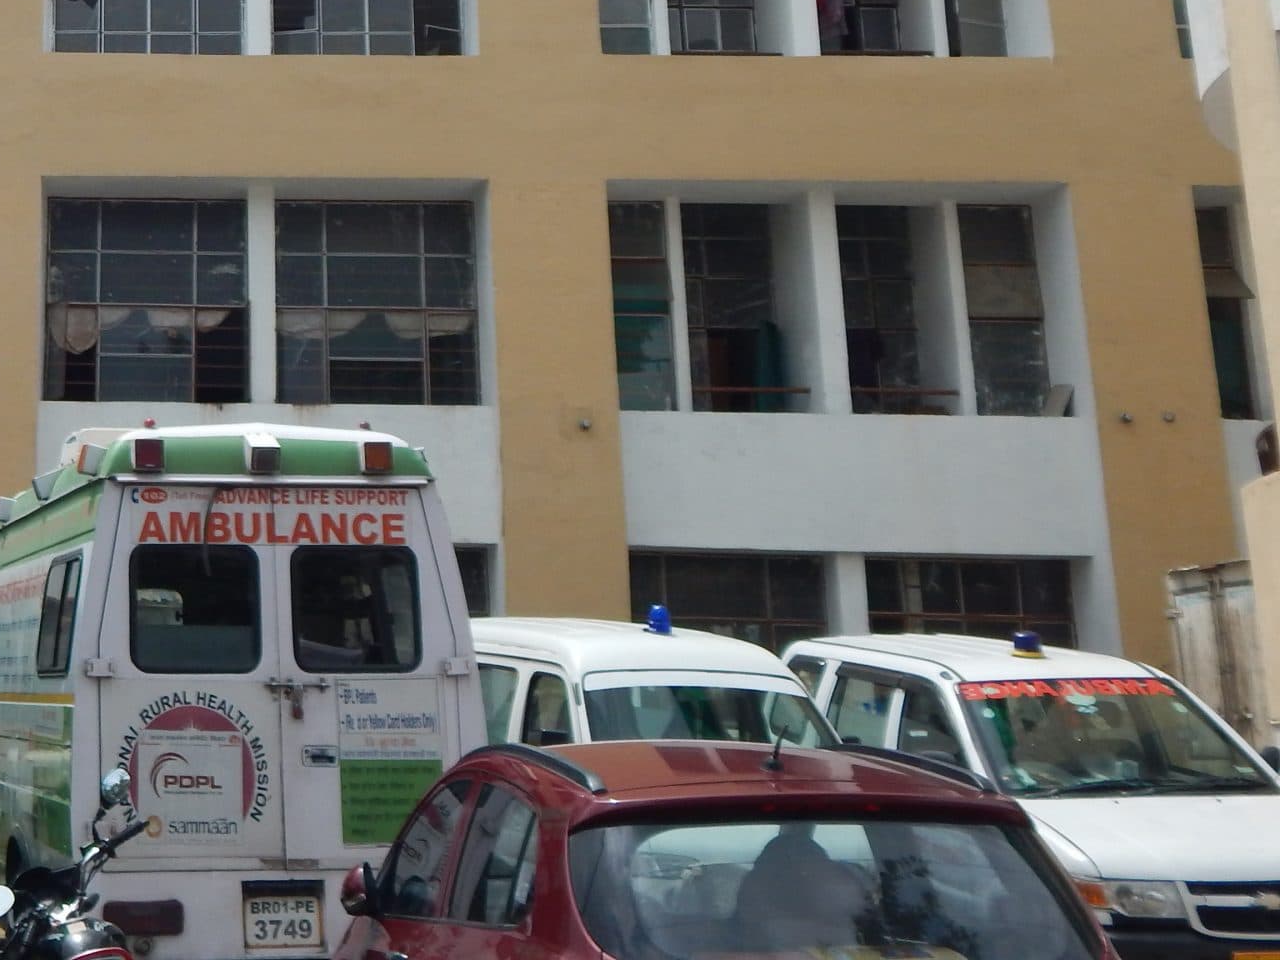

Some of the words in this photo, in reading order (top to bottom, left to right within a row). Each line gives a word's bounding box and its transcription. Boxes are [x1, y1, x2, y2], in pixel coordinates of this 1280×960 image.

[214, 488, 290, 504] ADVANCE
[296, 489, 329, 505] LIFE
[335, 490, 408, 506] SUPPORT
[138, 511, 406, 545] AMBULANCE
[139, 691, 192, 725] RURAL
[197, 692, 254, 736] HEALTH
[249, 736, 269, 823] MISSION
[163, 774, 223, 789] PDPL
[250, 900, 315, 914] BR01-PE
[255, 919, 312, 940] 3749
